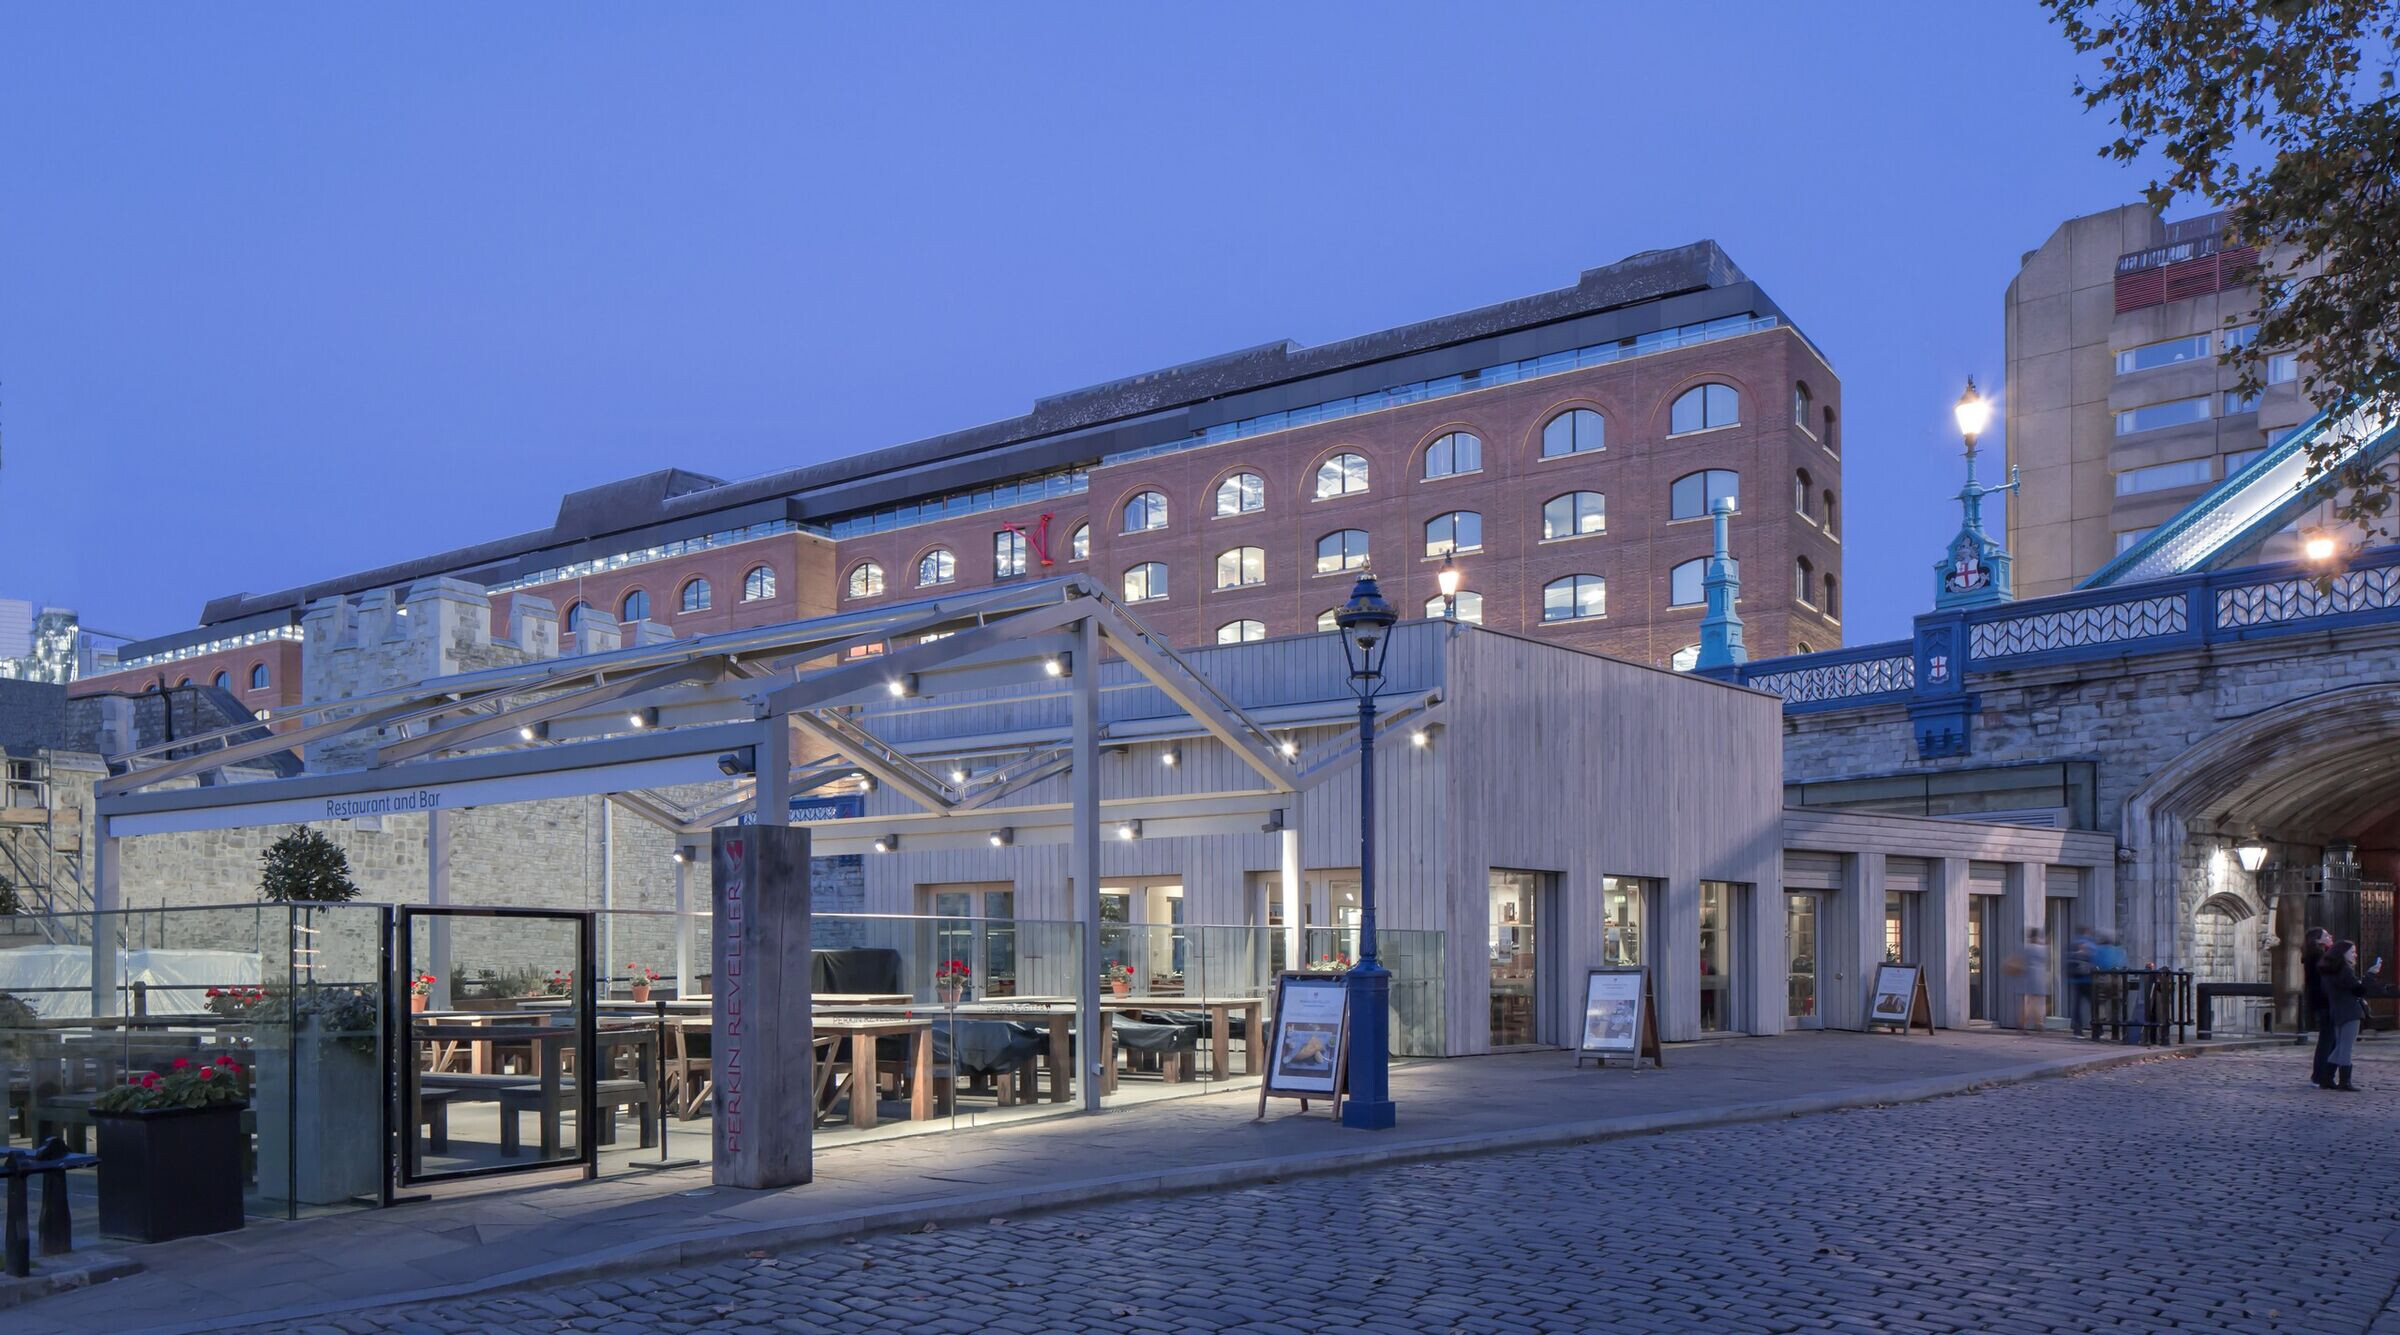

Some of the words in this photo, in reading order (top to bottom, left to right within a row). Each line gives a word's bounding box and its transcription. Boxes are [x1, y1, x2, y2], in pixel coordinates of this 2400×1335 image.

[327, 796, 389, 816] Restaurant
[393, 792, 416, 810] and
[420, 791, 440, 807] Bar
[728, 881, 742, 1036] REVELLER
[728, 1048, 742, 1152] PERKIN
